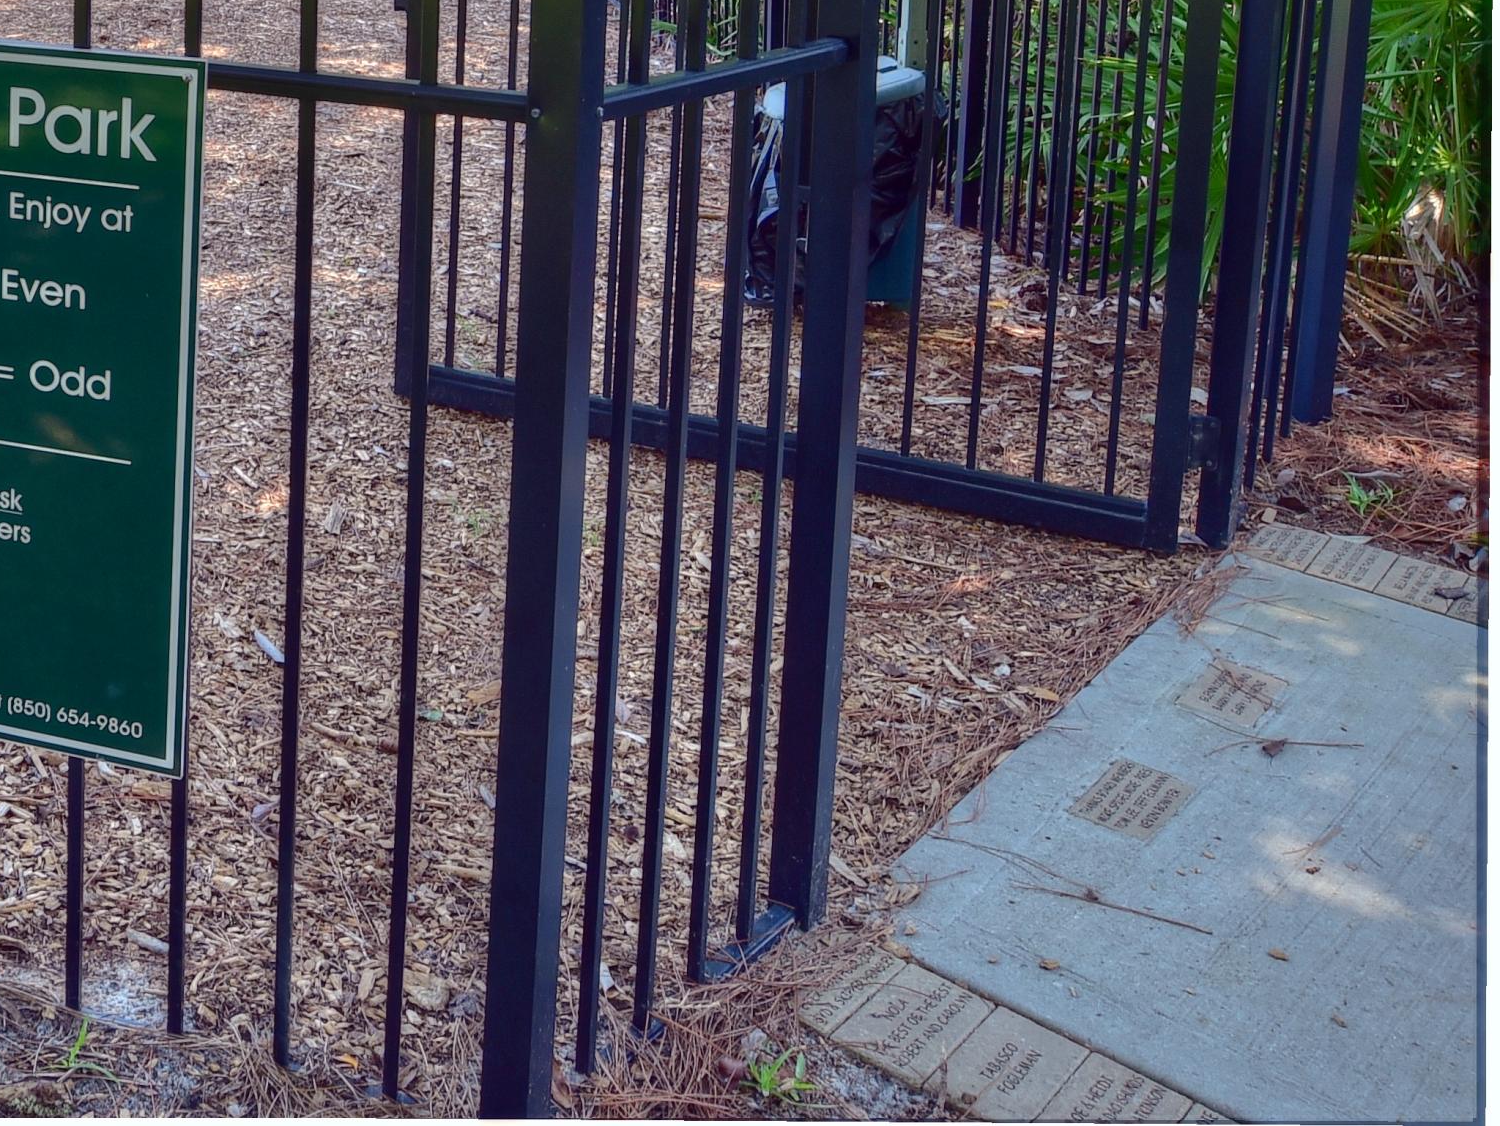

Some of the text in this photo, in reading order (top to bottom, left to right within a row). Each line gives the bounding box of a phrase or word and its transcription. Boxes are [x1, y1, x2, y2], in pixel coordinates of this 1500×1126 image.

[10, 87, 156, 161] Park
[10, 192, 91, 232] Enjoy
[101, 206, 133, 232] at
[2, 269, 85, 309] Even
[30, 361, 110, 400] Odd
[8, 697, 50, 722] (850)
[57, 708, 142, 738] 654-9860
[882, 999, 909, 1021] NOLA
[888, 1023, 912, 1043] BEST
[916, 998, 938, 1015] THE
[892, 1038, 927, 1068] ROBERT
[922, 1022, 944, 1041] AND
[980, 1042, 1018, 1079] TABASCO
[997, 1049, 1043, 1096] FOGLEMAN
[1084, 1075, 1114, 1103] HEIDI
